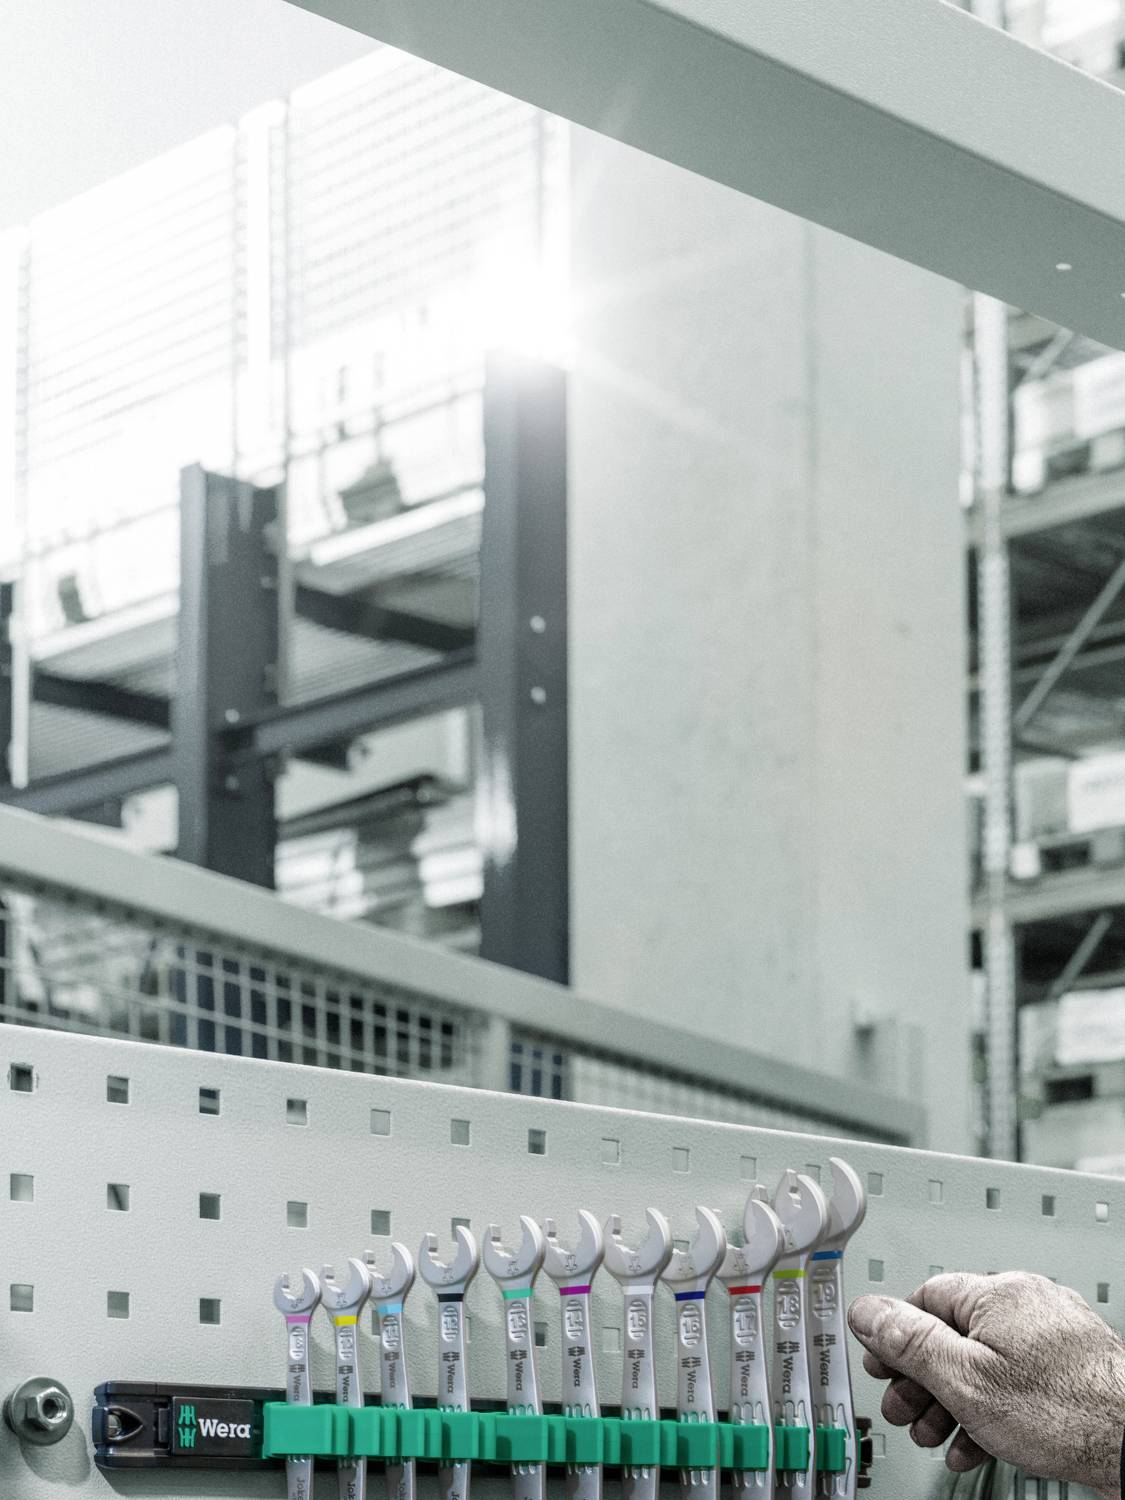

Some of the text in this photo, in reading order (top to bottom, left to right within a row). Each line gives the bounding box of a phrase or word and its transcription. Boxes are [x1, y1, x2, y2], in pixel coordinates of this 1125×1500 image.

[778, 1295, 800, 1315] 18
[813, 1283, 835, 1305] 19
[629, 1312, 647, 1329] 15
[682, 1318, 699, 1334] 16
[736, 1312, 756, 1331] 17
[448, 1363, 456, 1394] Wera
[515, 1361, 523, 1391] Wera
[573, 1358, 582, 1387] Wera
[632, 1360, 641, 1389] Wera
[741, 1363, 750, 1397] Wera
[783, 1356, 794, 1394] Wera
[820, 1349, 830, 1386] Wera
[687, 1369, 696, 1403] Wera
[198, 1418, 251, 1438] Wera
